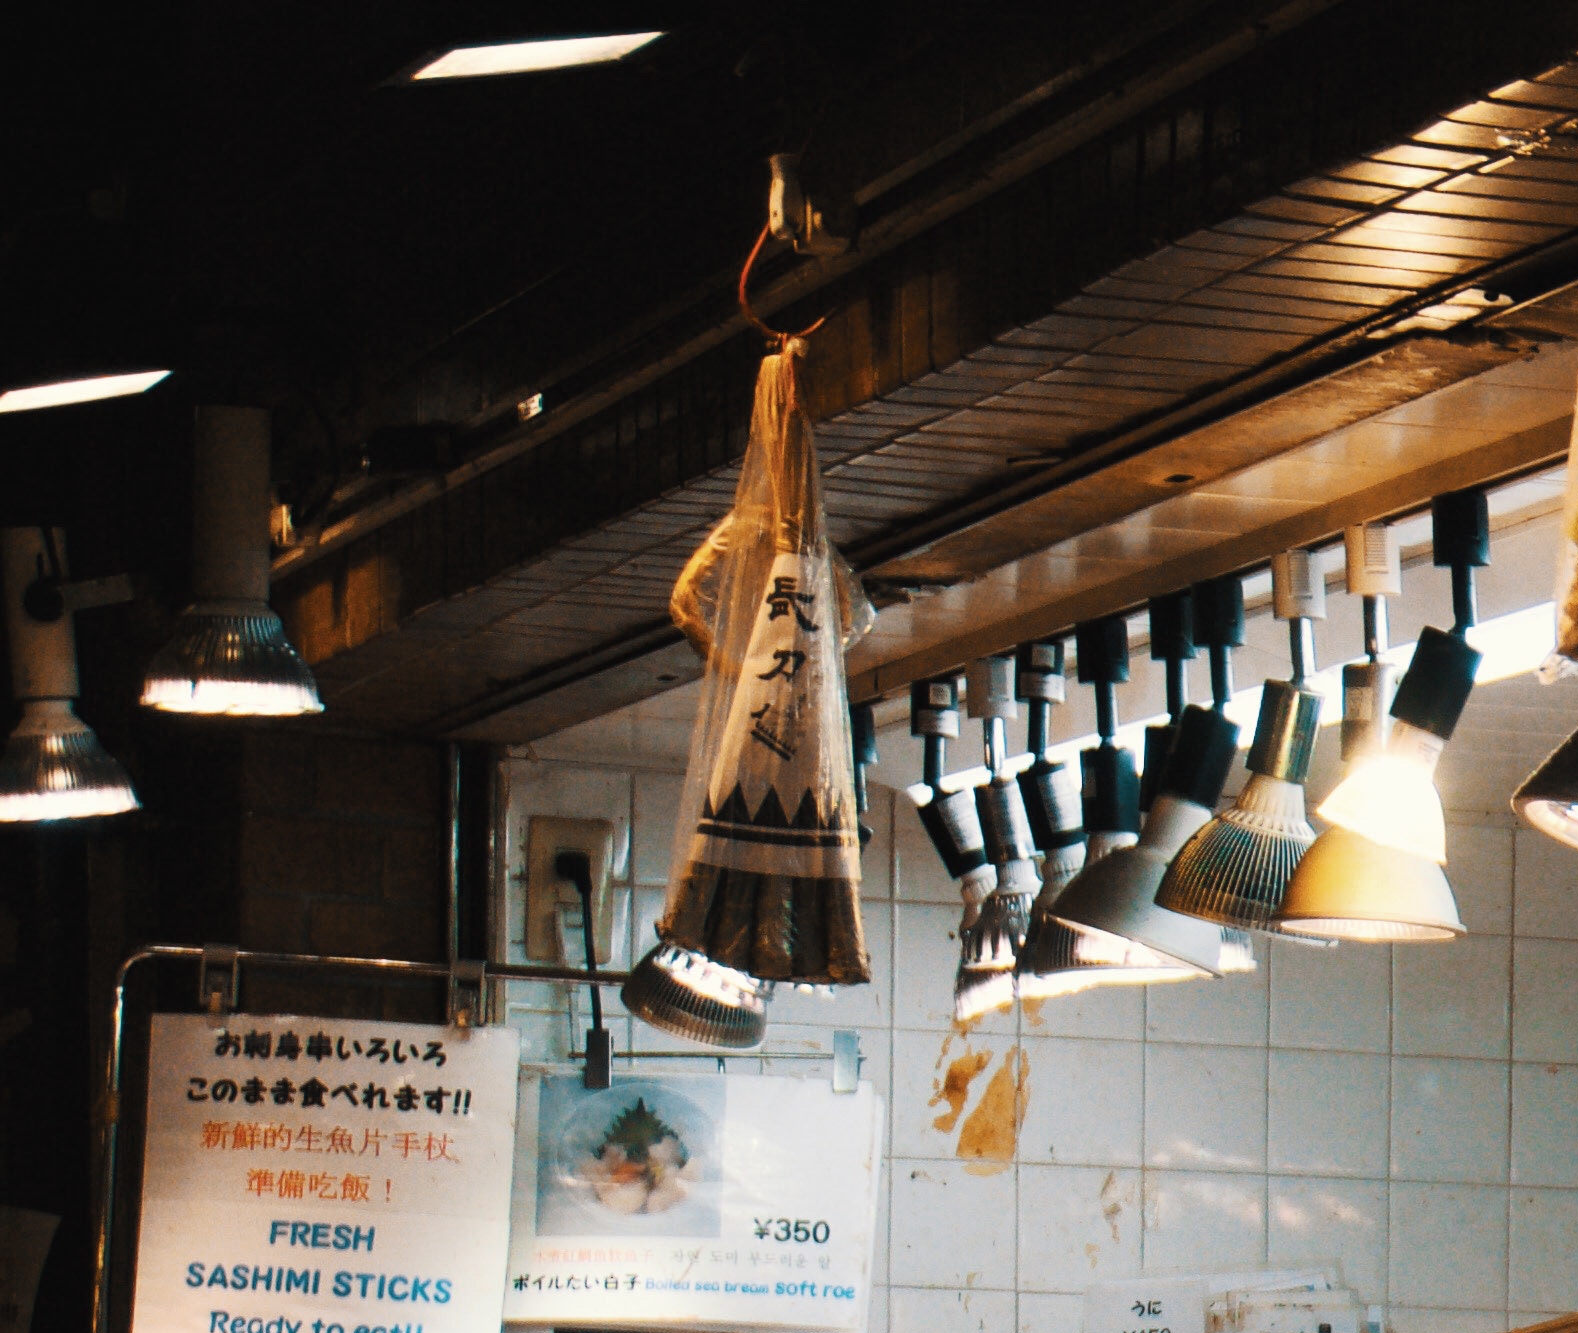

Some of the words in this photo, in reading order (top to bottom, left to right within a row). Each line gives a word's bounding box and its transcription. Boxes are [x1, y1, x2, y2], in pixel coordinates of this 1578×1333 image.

[215, 1028, 447, 1067] お刺身串いろいろ
[269, 1220, 376, 1252] FRESH
[753, 1216, 831, 1244] ¥350
[186, 1261, 321, 1295] SASHIMI
[332, 1269, 453, 1304] STICKS
[513, 1273, 641, 1291] ボイルたい白子
[774, 1280, 816, 1298] soft
[822, 1284, 856, 1299] roe
[1131, 1300, 1162, 1316] うに
